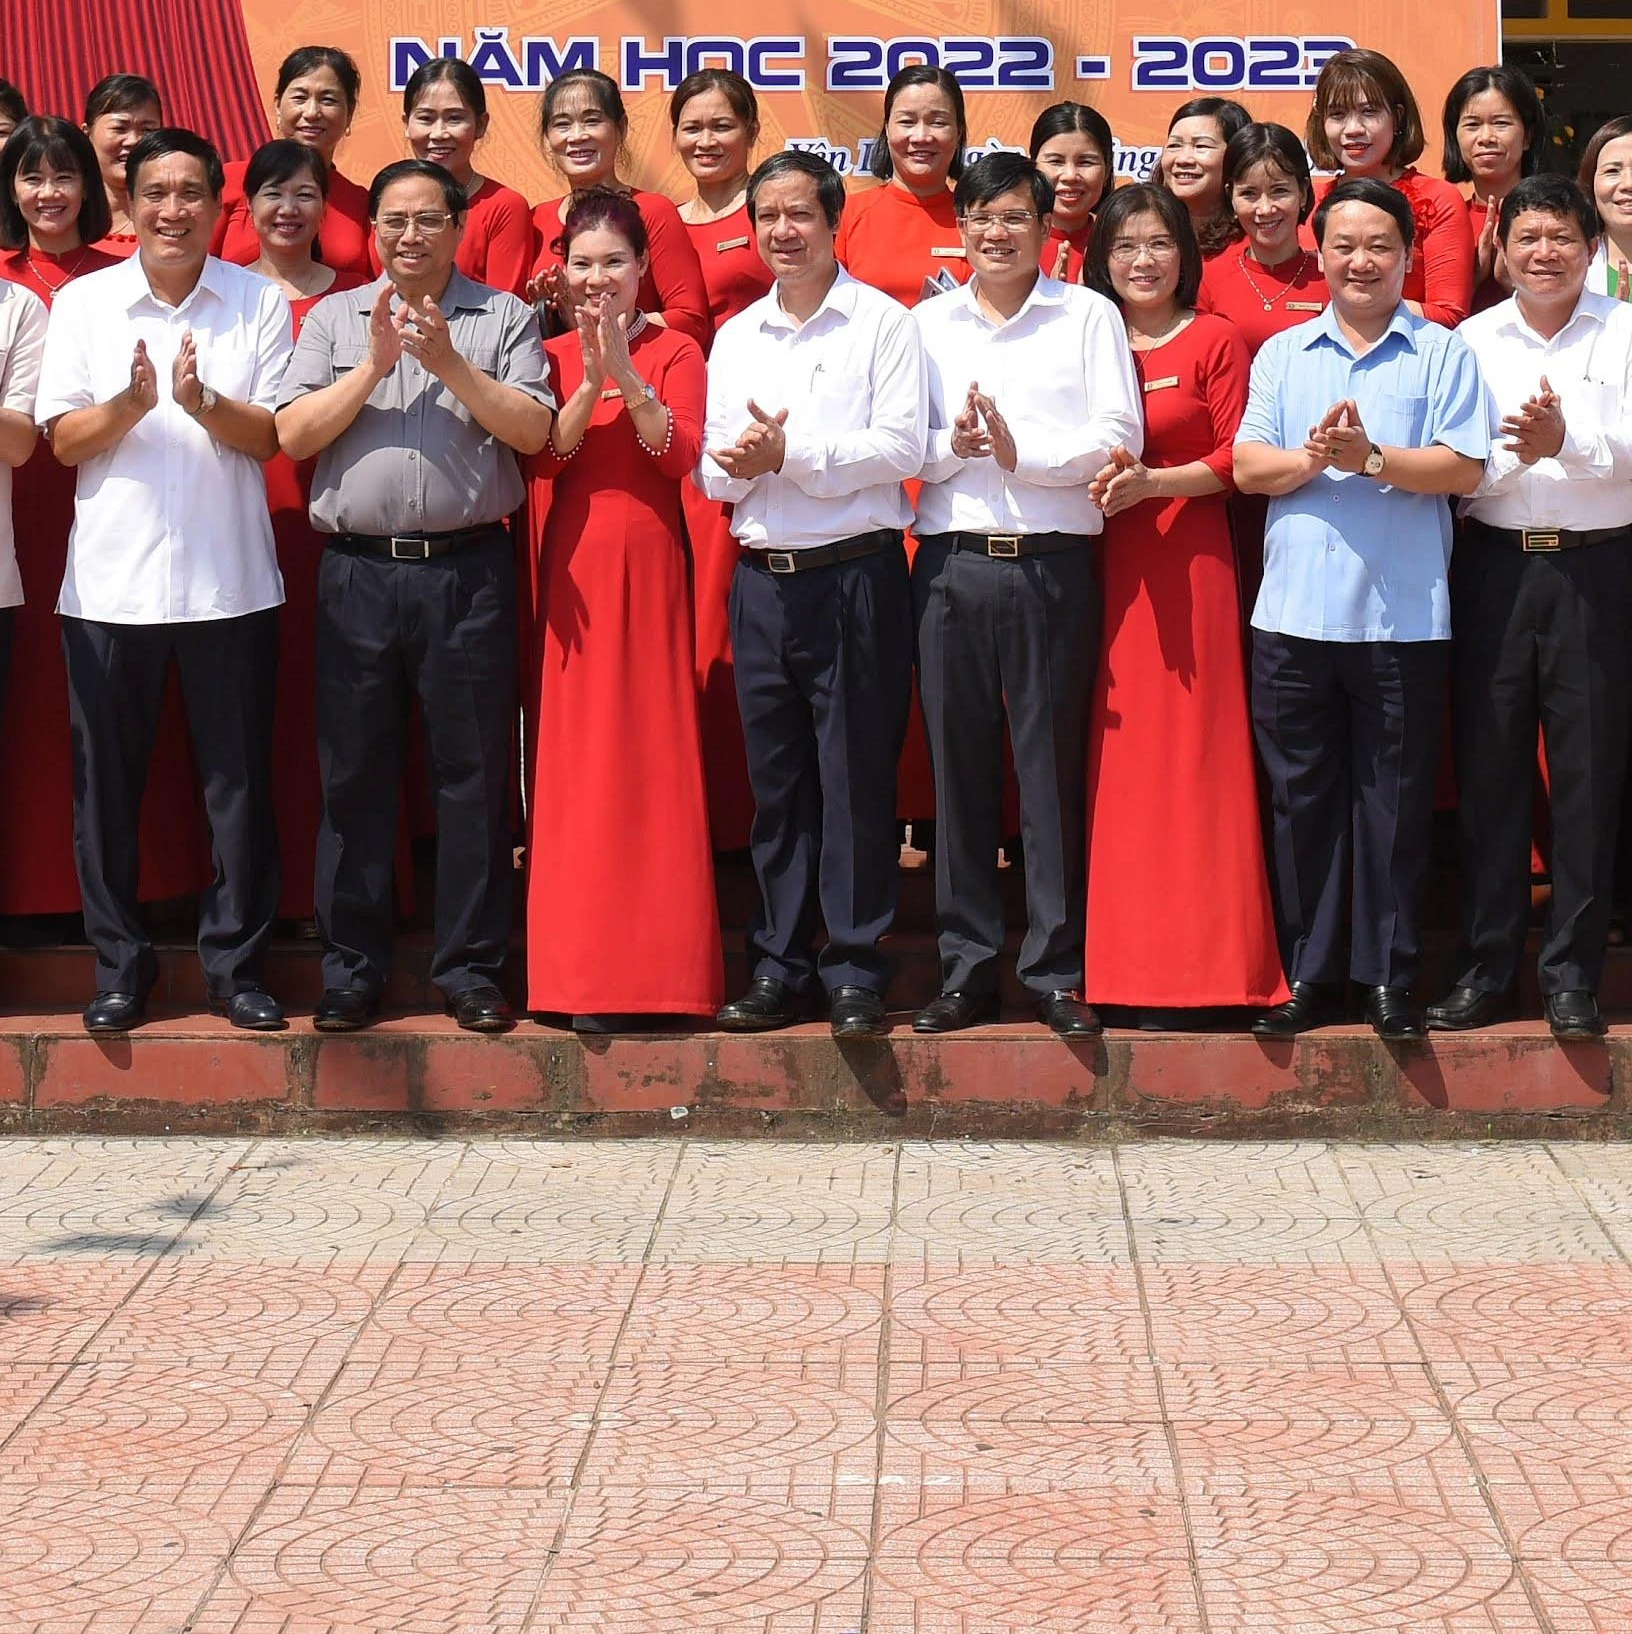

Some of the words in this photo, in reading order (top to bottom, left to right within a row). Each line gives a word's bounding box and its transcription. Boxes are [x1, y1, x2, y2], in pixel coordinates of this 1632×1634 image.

[394, 30, 595, 87] NĂM
[832, 40, 1051, 86] 2022
[1081, 61, 1105, 74] -
